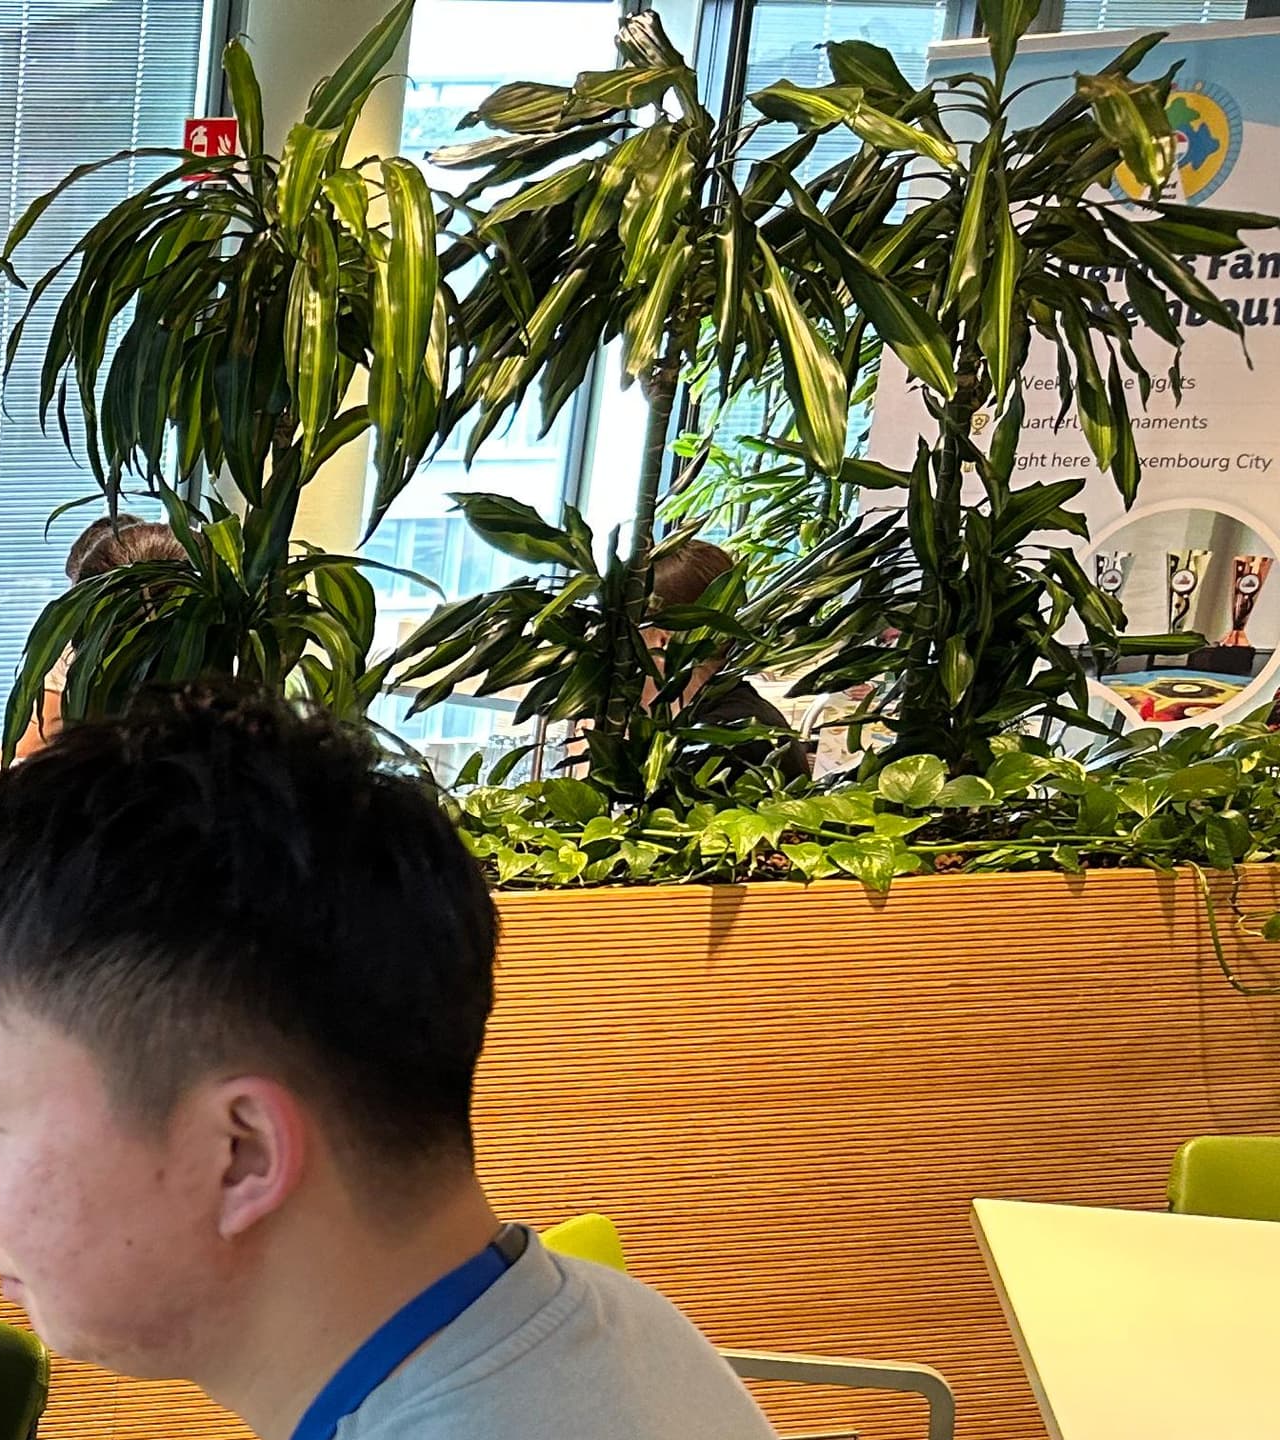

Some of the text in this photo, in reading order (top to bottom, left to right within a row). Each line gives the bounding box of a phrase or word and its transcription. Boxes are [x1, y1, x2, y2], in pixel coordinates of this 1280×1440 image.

[1051, 452, 1090, 468] here
[1139, 452, 1230, 472] xembourg
[1236, 453, 1273, 472] City
